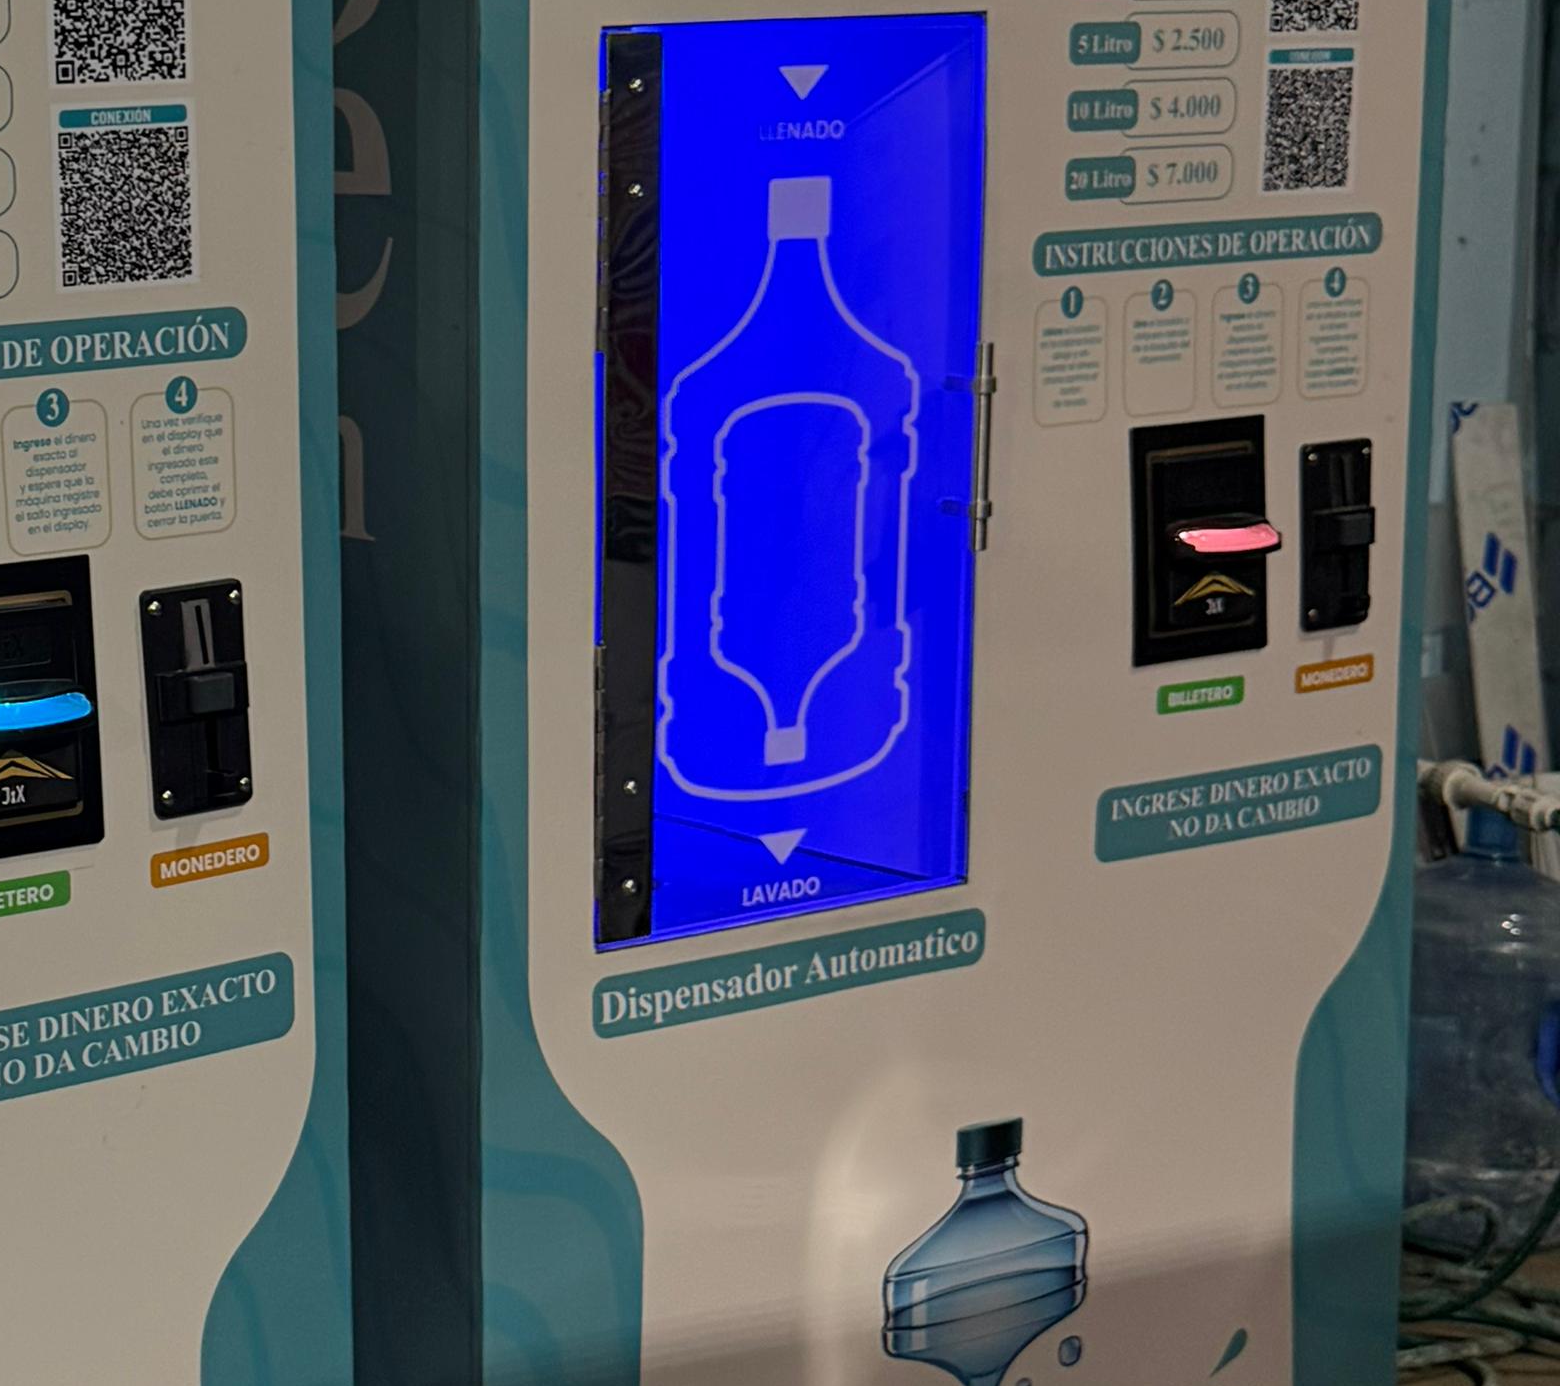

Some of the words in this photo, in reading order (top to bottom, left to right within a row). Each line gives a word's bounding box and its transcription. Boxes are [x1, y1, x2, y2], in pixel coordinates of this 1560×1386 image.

[1077, 37, 1087, 54] 5
[1091, 33, 1133, 53] Litro
[1152, 29, 1165, 53] $
[1171, 26, 1226, 52] 2.500
[90, 109, 151, 126] CONEXIÓN
[1072, 102, 1090, 121] 10
[1094, 99, 1134, 120] Litro
[1149, 97, 1162, 120] $
[1167, 93, 1222, 119] 4.000
[759, 119, 845, 141] LLENADO
[1069, 170, 1089, 189] 20
[1092, 166, 1133, 188] Litro
[1146, 164, 1160, 188] $
[1165, 160, 1219, 186] 7.000
[1045, 233, 1212, 270] INSTRUCCIONES
[1218, 233, 1245, 256] DE
[1250, 217, 1372, 254] OPERACIÓN
[1157, 283, 1167, 305] 2
[1243, 276, 1254, 299] 3
[1330, 269, 1340, 293] 4
[1, 337, 42, 369] DE
[50, 316, 231, 366] OPERACIÓN
[46, 393, 60, 421] 3
[175, 381, 188, 407] 4
[1301, 664, 1368, 688] MONEDERO
[1168, 685, 1233, 708] BILLETERO
[1111, 783, 1203, 821] INGRESE
[1210, 770, 1289, 803] DINERO
[1293, 757, 1371, 790] EXACTO
[1169, 816, 1199, 842] NO
[1205, 808, 1235, 834] DA
[1237, 795, 1320, 828] CAMBIO
[159, 845, 260, 878] MONEDERO
[742, 876, 820, 908] LAVADO
[599, 961, 799, 1025] Dispensador
[805, 927, 978, 985] Automatico
[40, 995, 153, 1040] DINERO
[161, 969, 276, 1014] EXACTO
[34, 1046, 76, 1080] DA
[82, 1020, 201, 1068] CAMBIO
